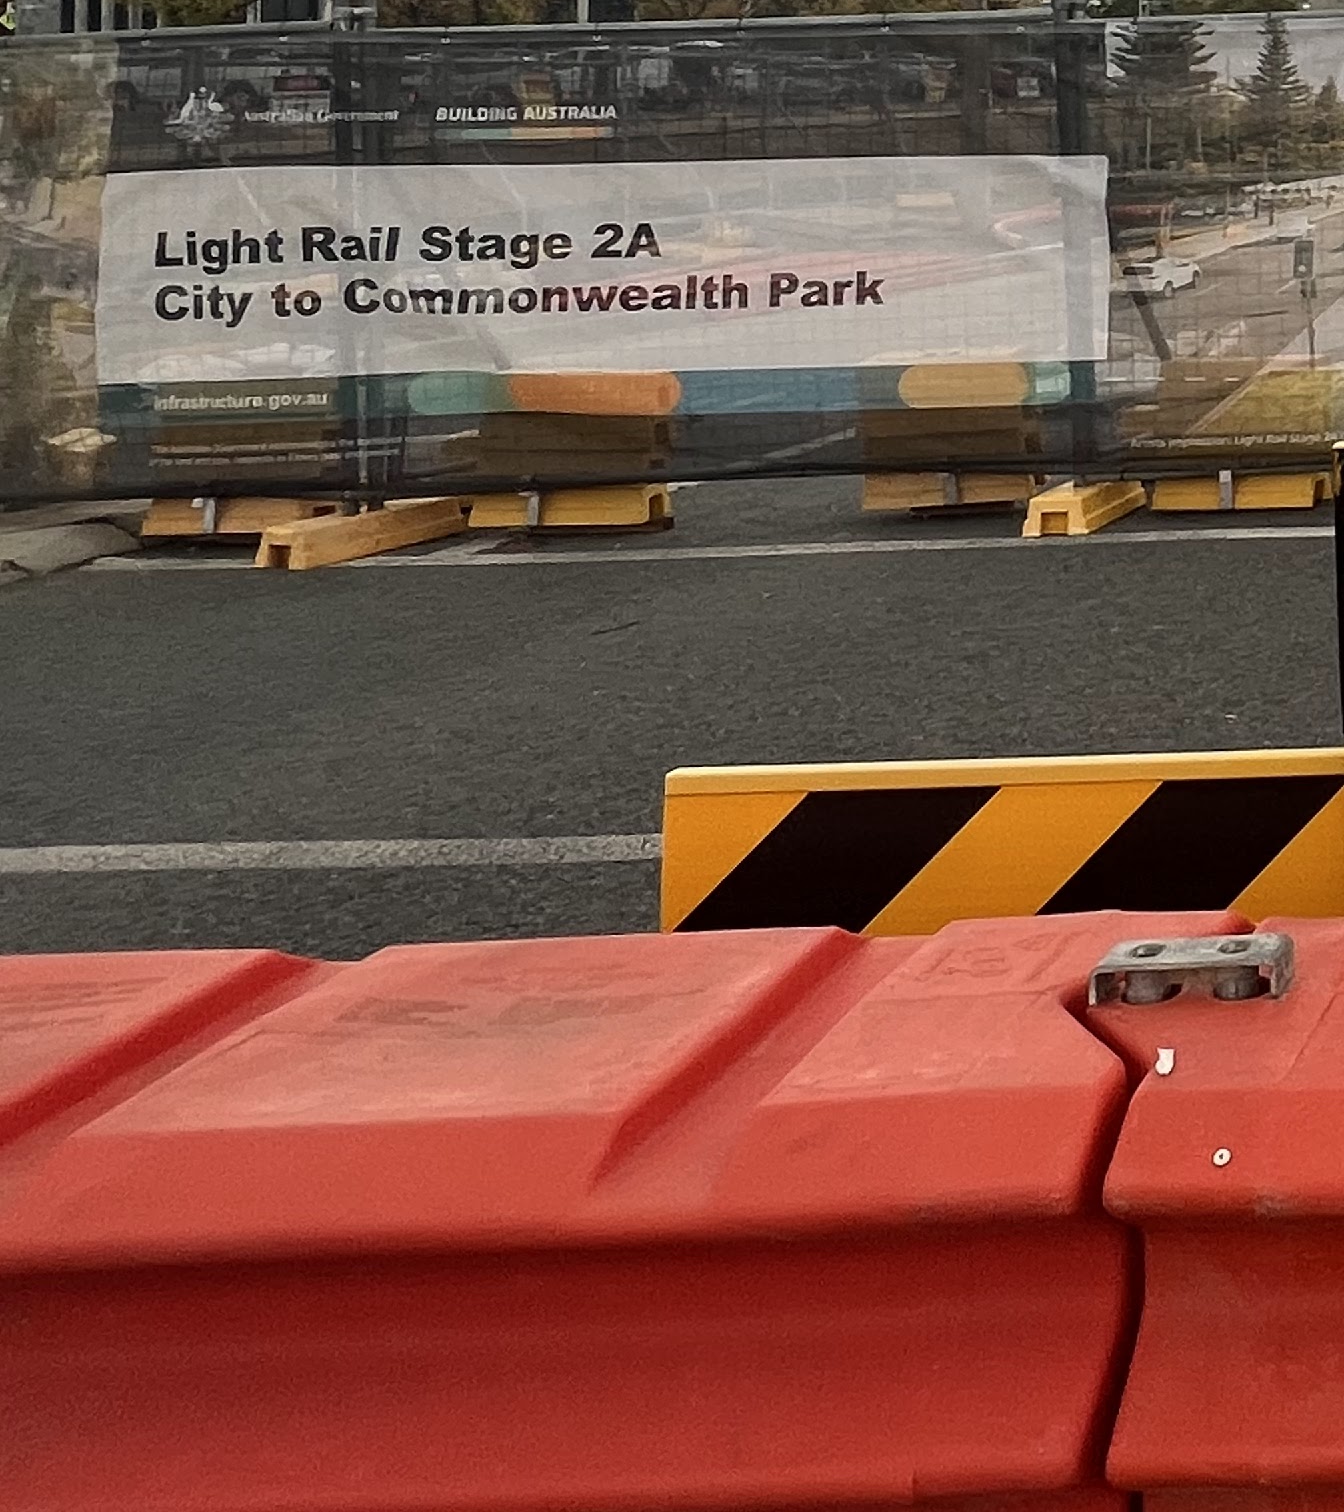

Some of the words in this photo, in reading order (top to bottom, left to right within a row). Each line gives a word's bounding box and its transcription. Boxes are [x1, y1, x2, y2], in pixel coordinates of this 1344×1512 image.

[435, 107, 518, 121] BUILDING
[522, 105, 617, 120] AUSTRALIA
[154, 228, 285, 275] Light
[301, 226, 401, 262] Rail
[418, 225, 573, 270] Stage
[590, 222, 662, 258] 2A
[155, 283, 253, 328] City
[270, 282, 322, 317] to
[343, 274, 750, 315] Commonwealth
[768, 270, 884, 308] Park
[154, 393, 329, 411] infrastructure.gov.au
